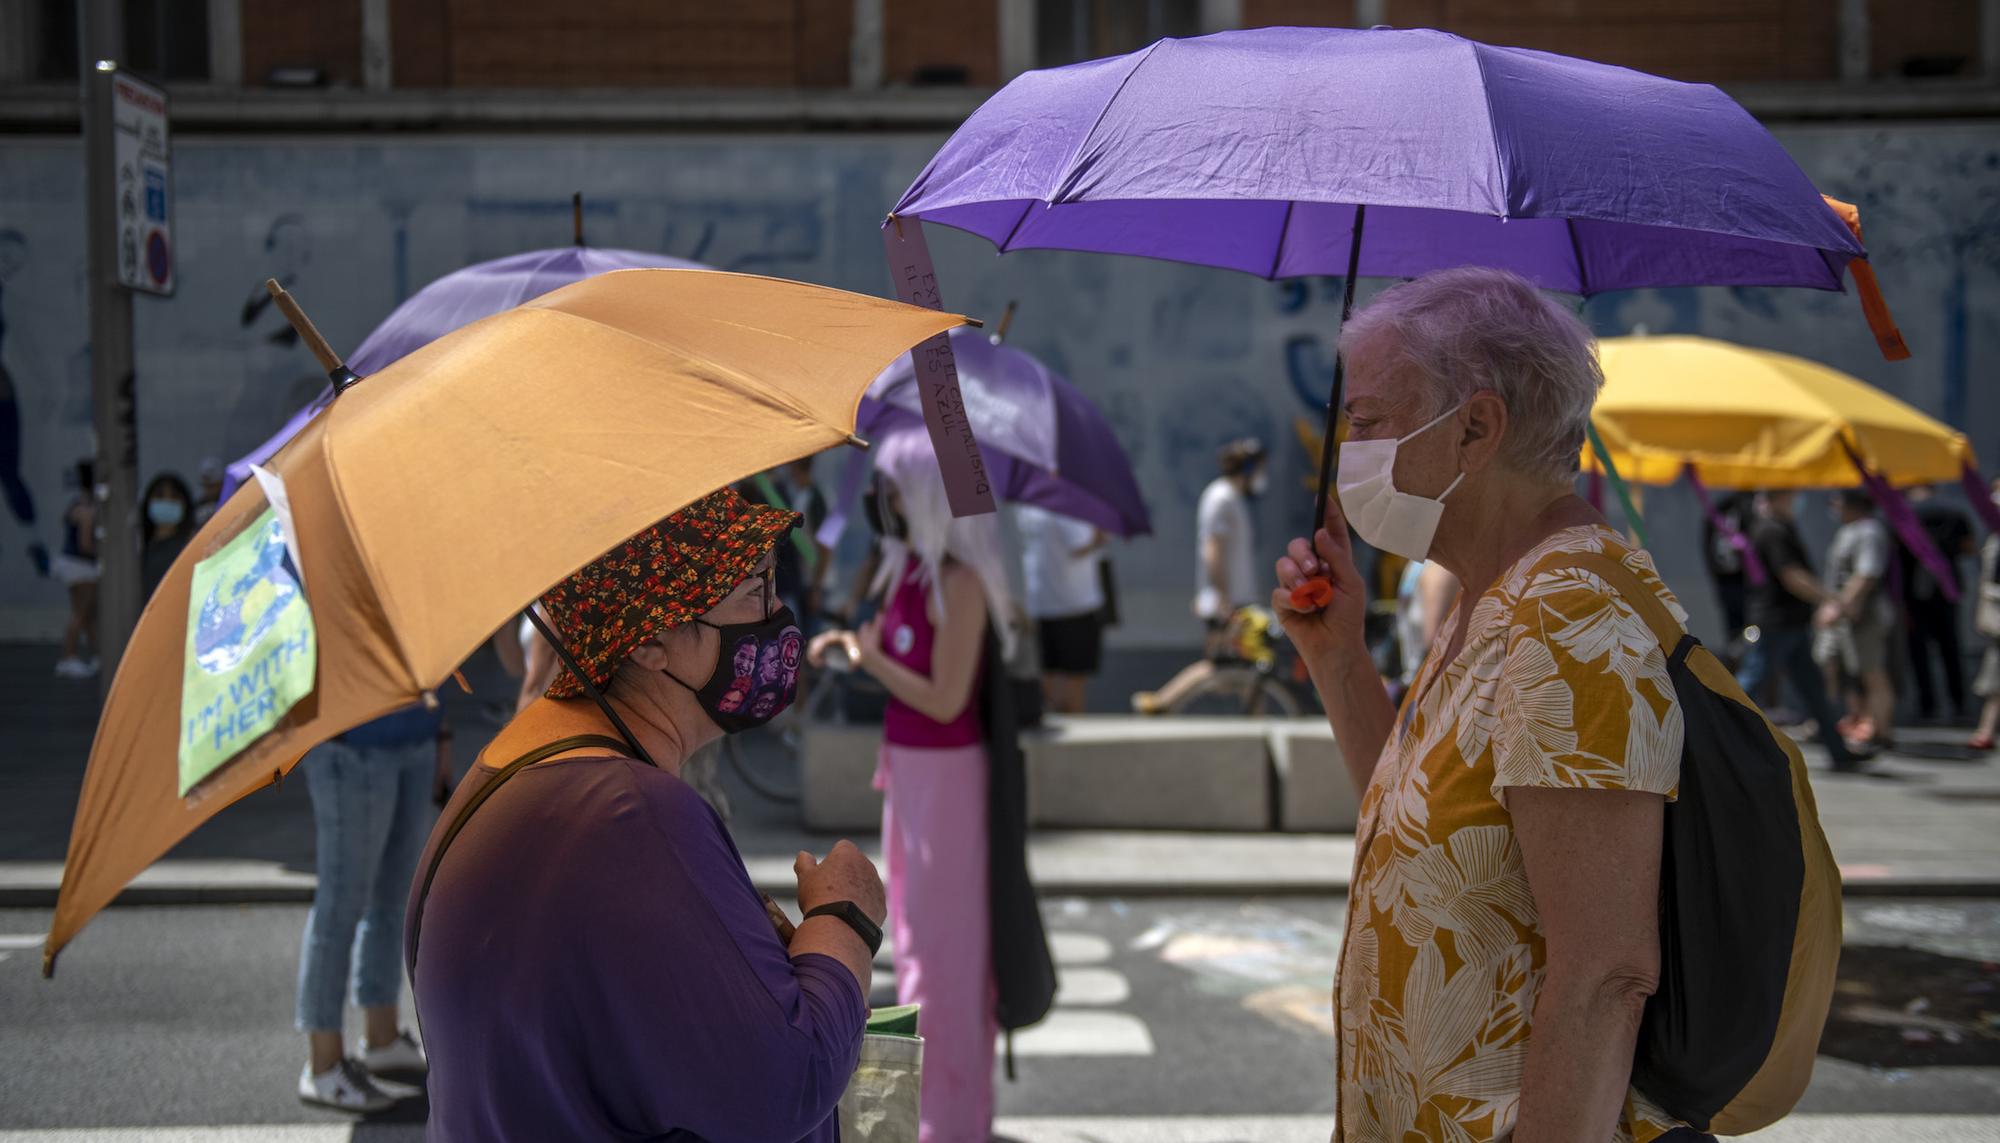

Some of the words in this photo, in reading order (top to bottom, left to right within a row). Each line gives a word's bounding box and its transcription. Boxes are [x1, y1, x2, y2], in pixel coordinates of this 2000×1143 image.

[926, 348, 941, 373] ES
[933, 383, 955, 436] AZUL
[951, 386, 989, 495] CAPITALISMO
[229, 628, 308, 705] WITH
[214, 687, 276, 750] HER
